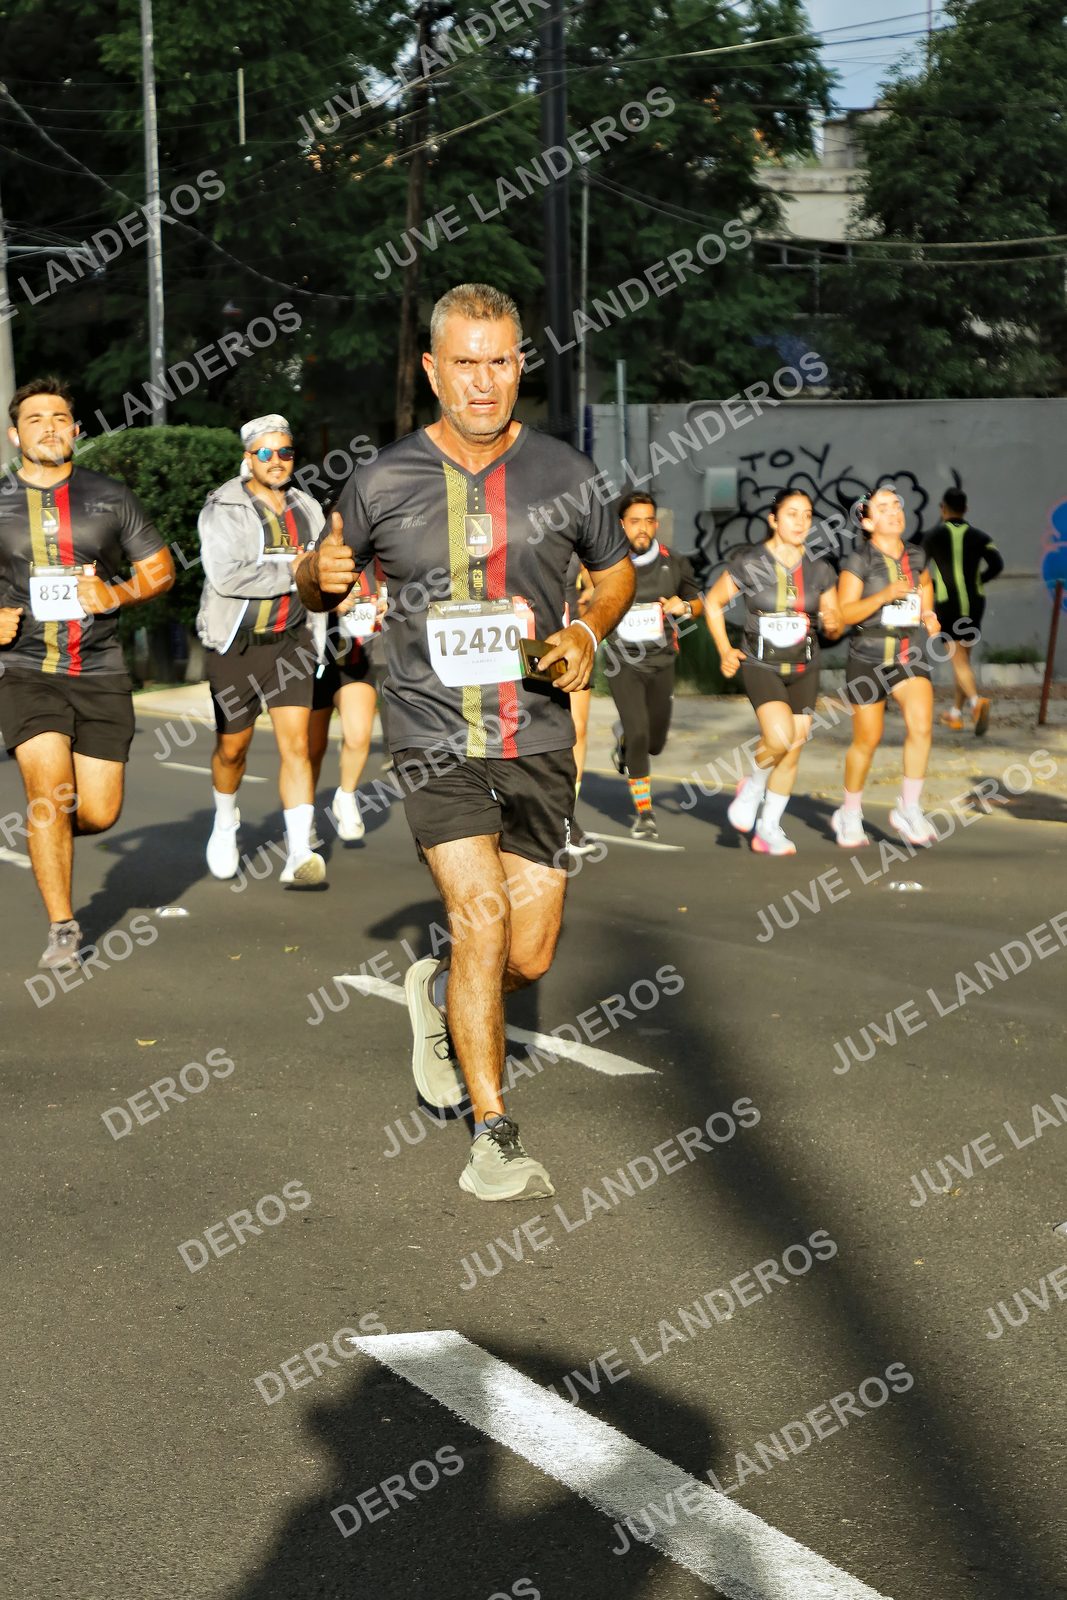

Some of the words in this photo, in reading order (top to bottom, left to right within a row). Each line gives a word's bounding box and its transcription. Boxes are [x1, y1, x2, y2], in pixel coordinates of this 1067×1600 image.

[739, 443, 830, 479] TOY
[40, 584, 78, 600] 852
[434, 624, 521, 657] 12420
